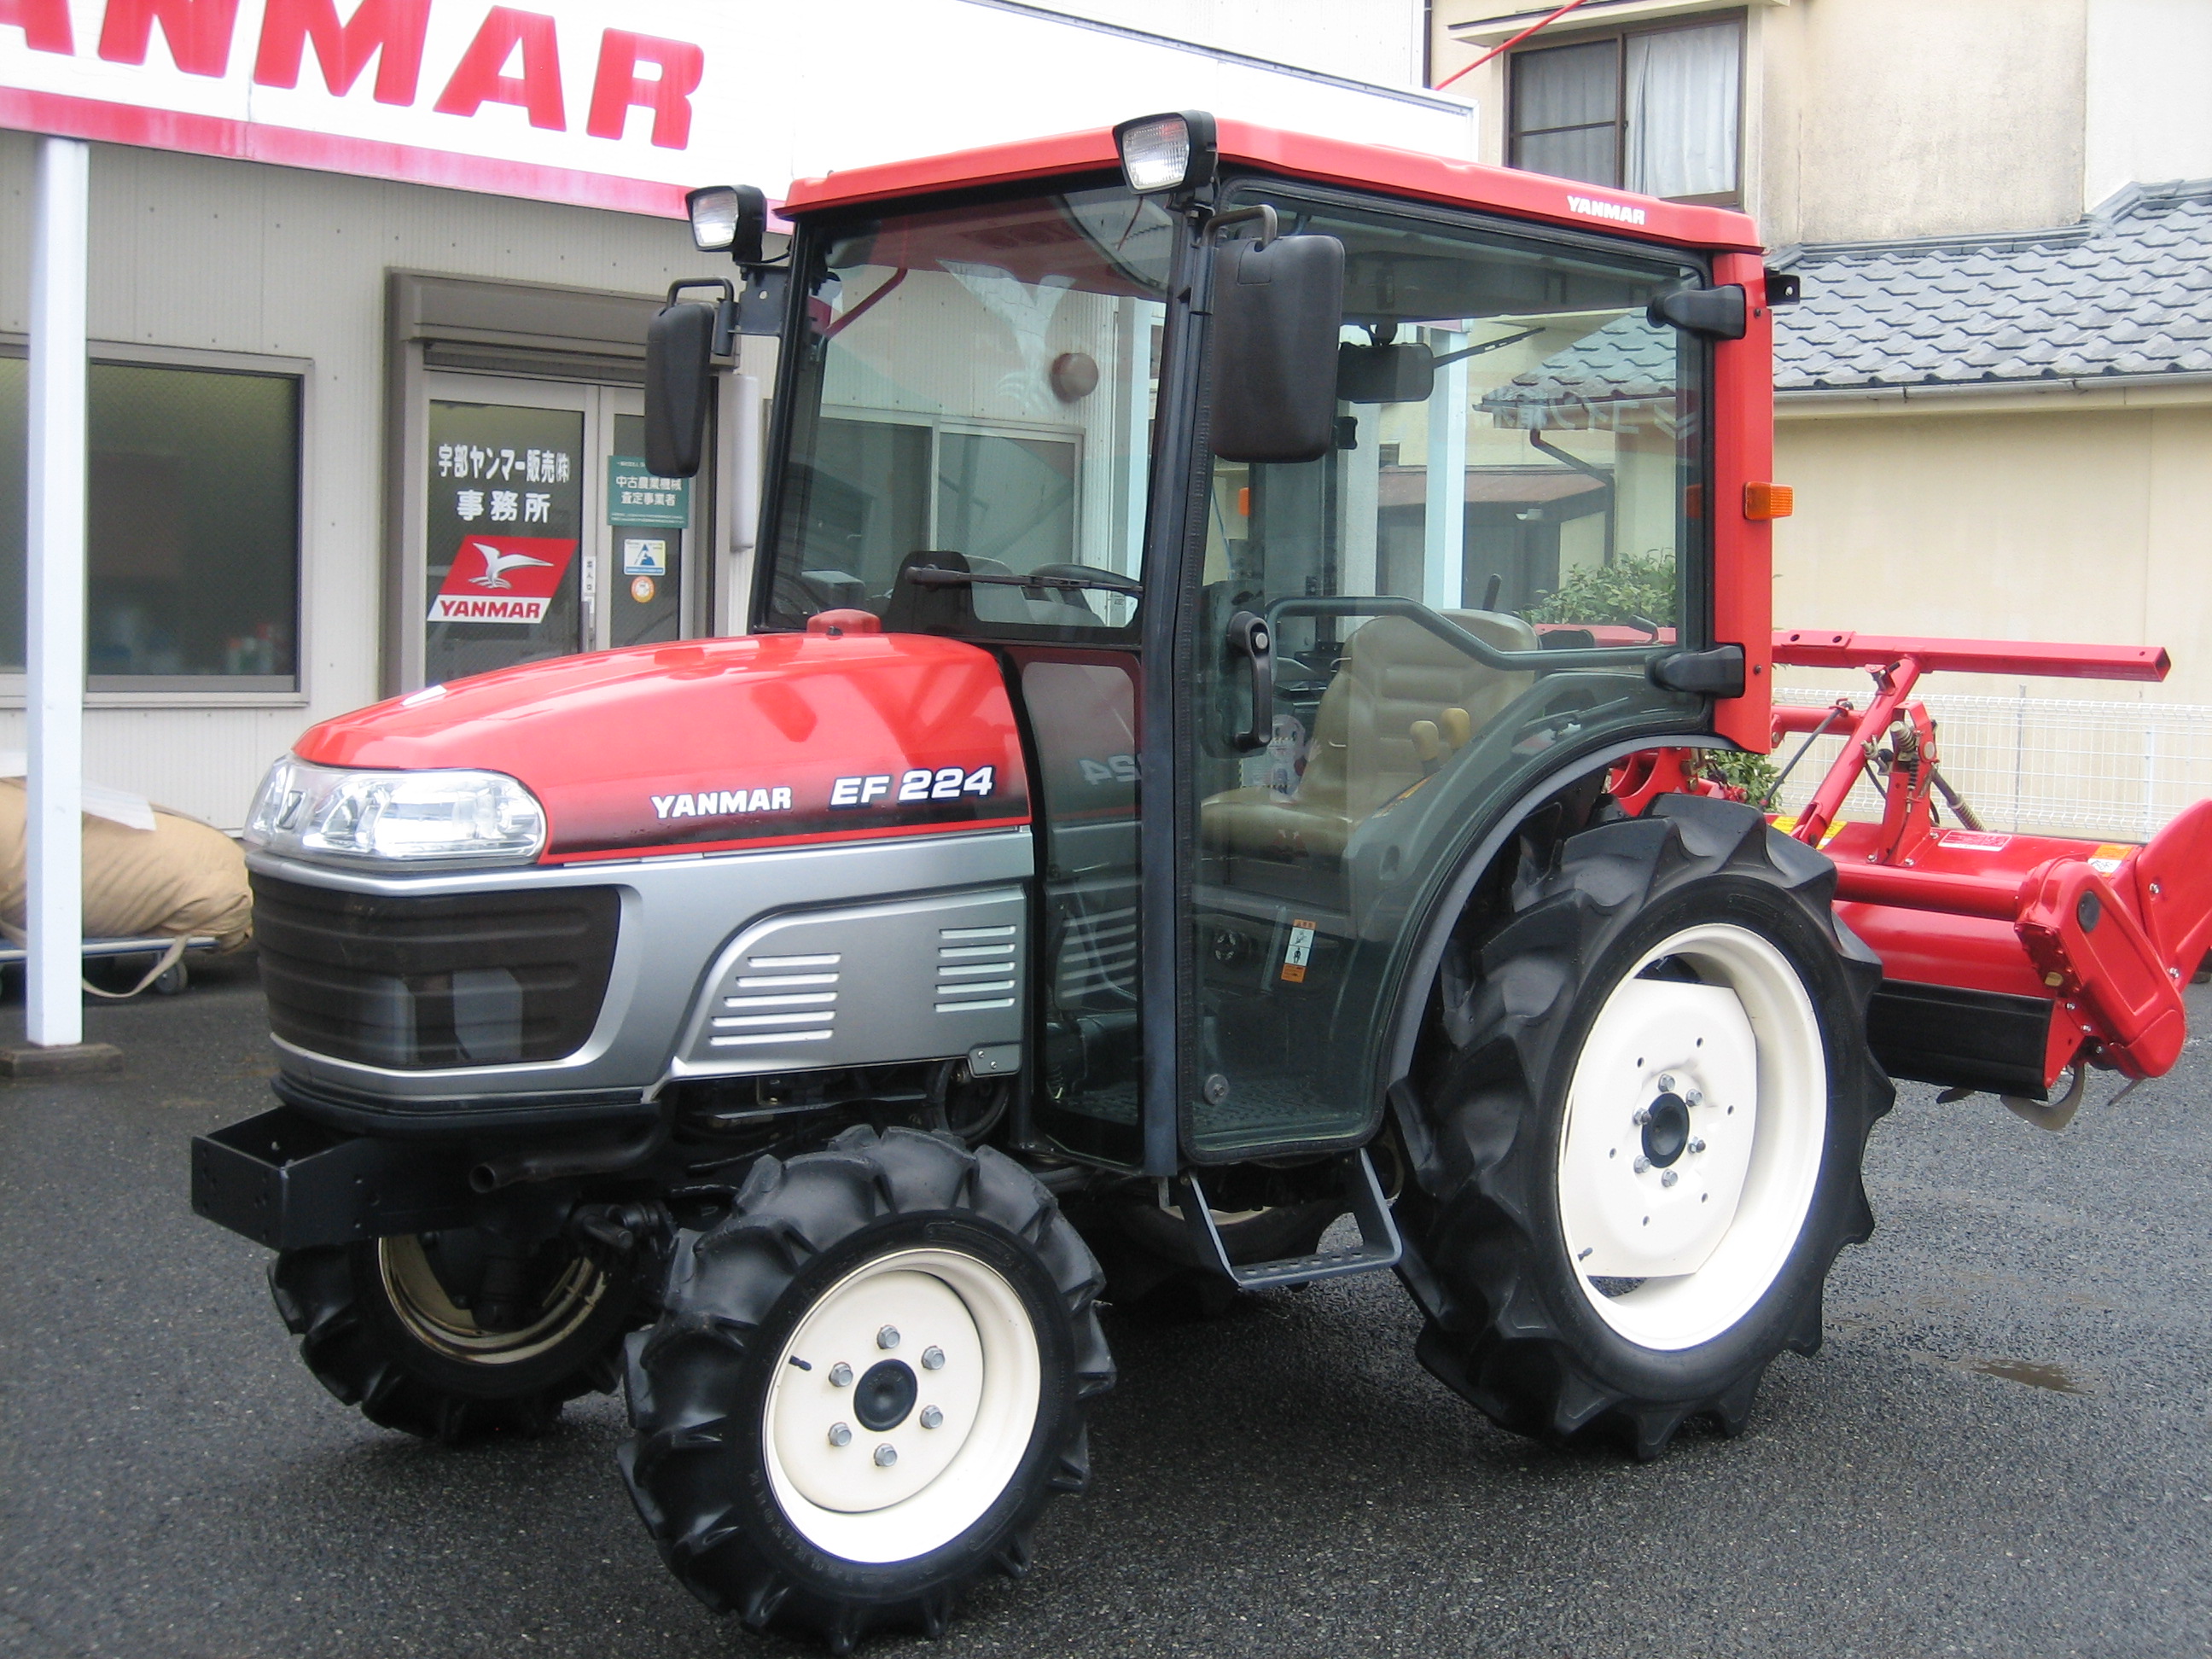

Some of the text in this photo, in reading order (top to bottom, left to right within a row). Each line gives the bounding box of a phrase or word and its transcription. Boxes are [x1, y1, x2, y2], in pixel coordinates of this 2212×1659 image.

[1567, 195, 1645, 225] YANMAR
[456, 489, 551, 524] 事務所
[439, 600, 542, 619] YANMAR
[650, 786, 792, 819] YANMAR
[829, 766, 994, 807] EF 224
